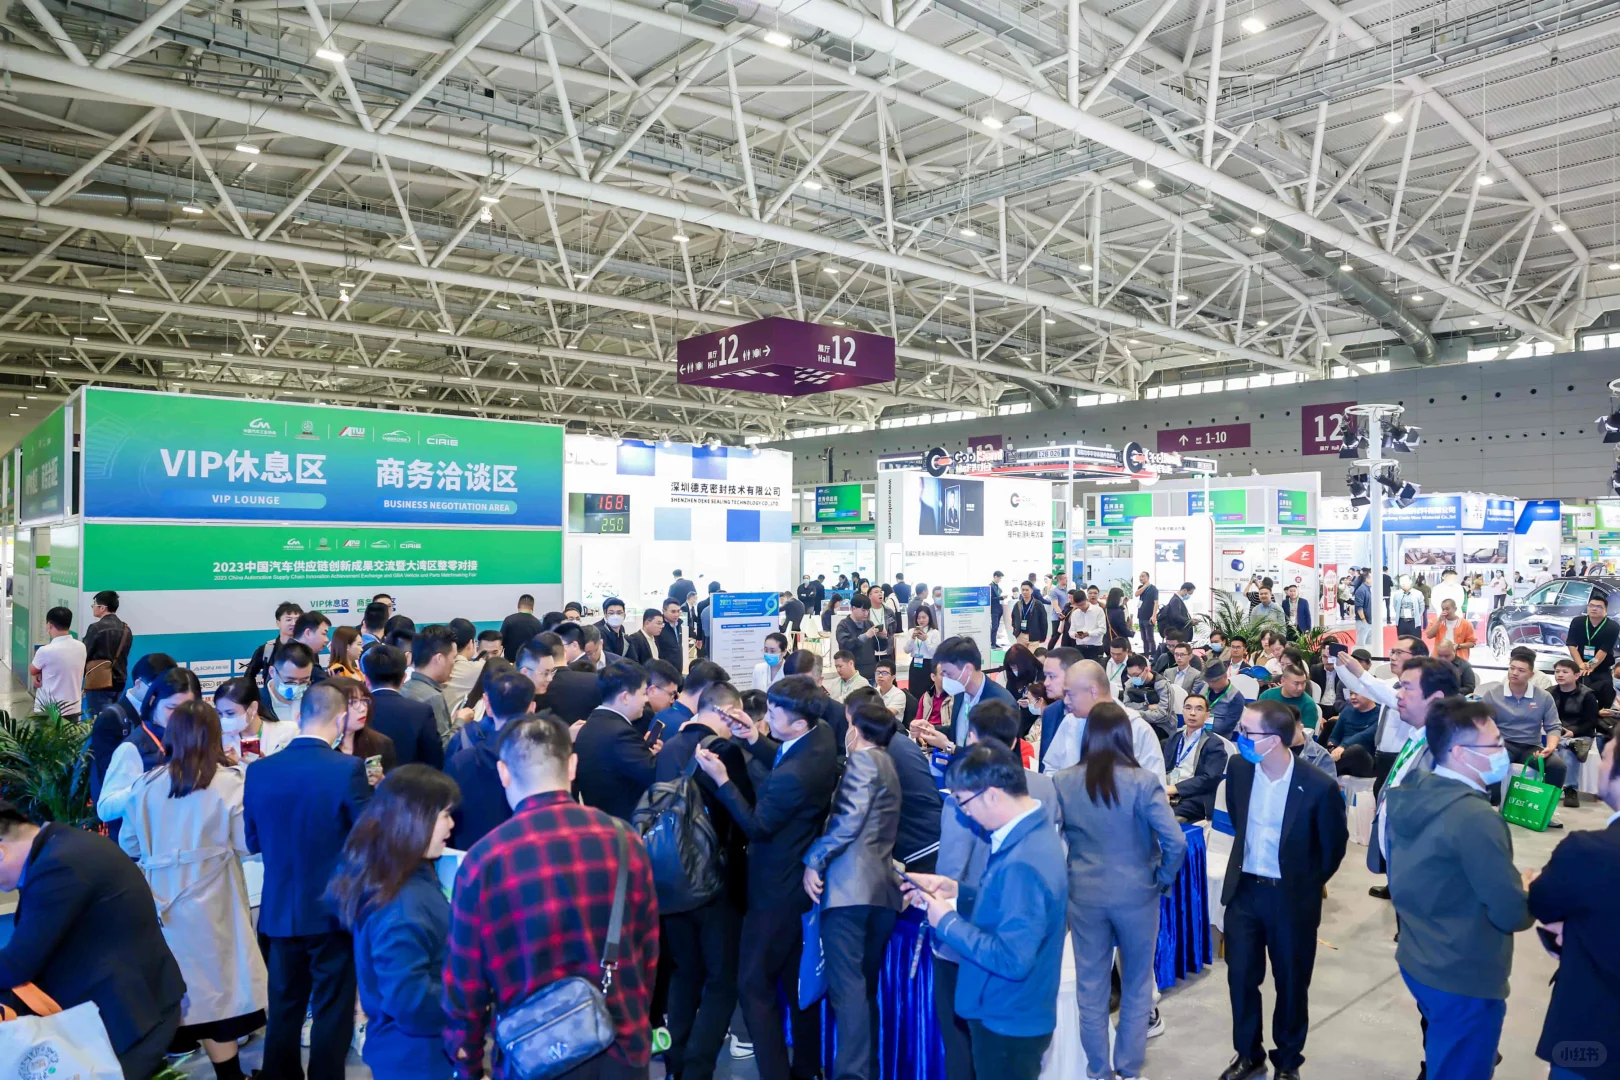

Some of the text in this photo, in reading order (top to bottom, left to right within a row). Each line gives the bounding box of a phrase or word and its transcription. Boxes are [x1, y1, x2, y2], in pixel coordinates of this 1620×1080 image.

[718, 334, 739, 366] 12
[832, 335, 857, 367] 12
[707, 361, 717, 370] Hall
[817, 354, 830, 364] Hall
[1314, 413, 1343, 442] 12
[1205, 431, 1227, 444] 1-10
[160, 448, 327, 485] VIP休息区
[376, 457, 518, 493] 商务洽谈区
[670, 481, 781, 497] 深圳德克密封技术有限公司
[211, 494, 280, 505] VIP LOUNGE
[383, 499, 510, 512] BUSINESS NEGOTIATION AREA
[598, 494, 624, 510] 168
[601, 517, 624, 532] 250
[212, 559, 478, 573] 2023中国汽车供应链创新成果交流暨大湾区整零对接
[310, 598, 350, 608] VIP休息区
